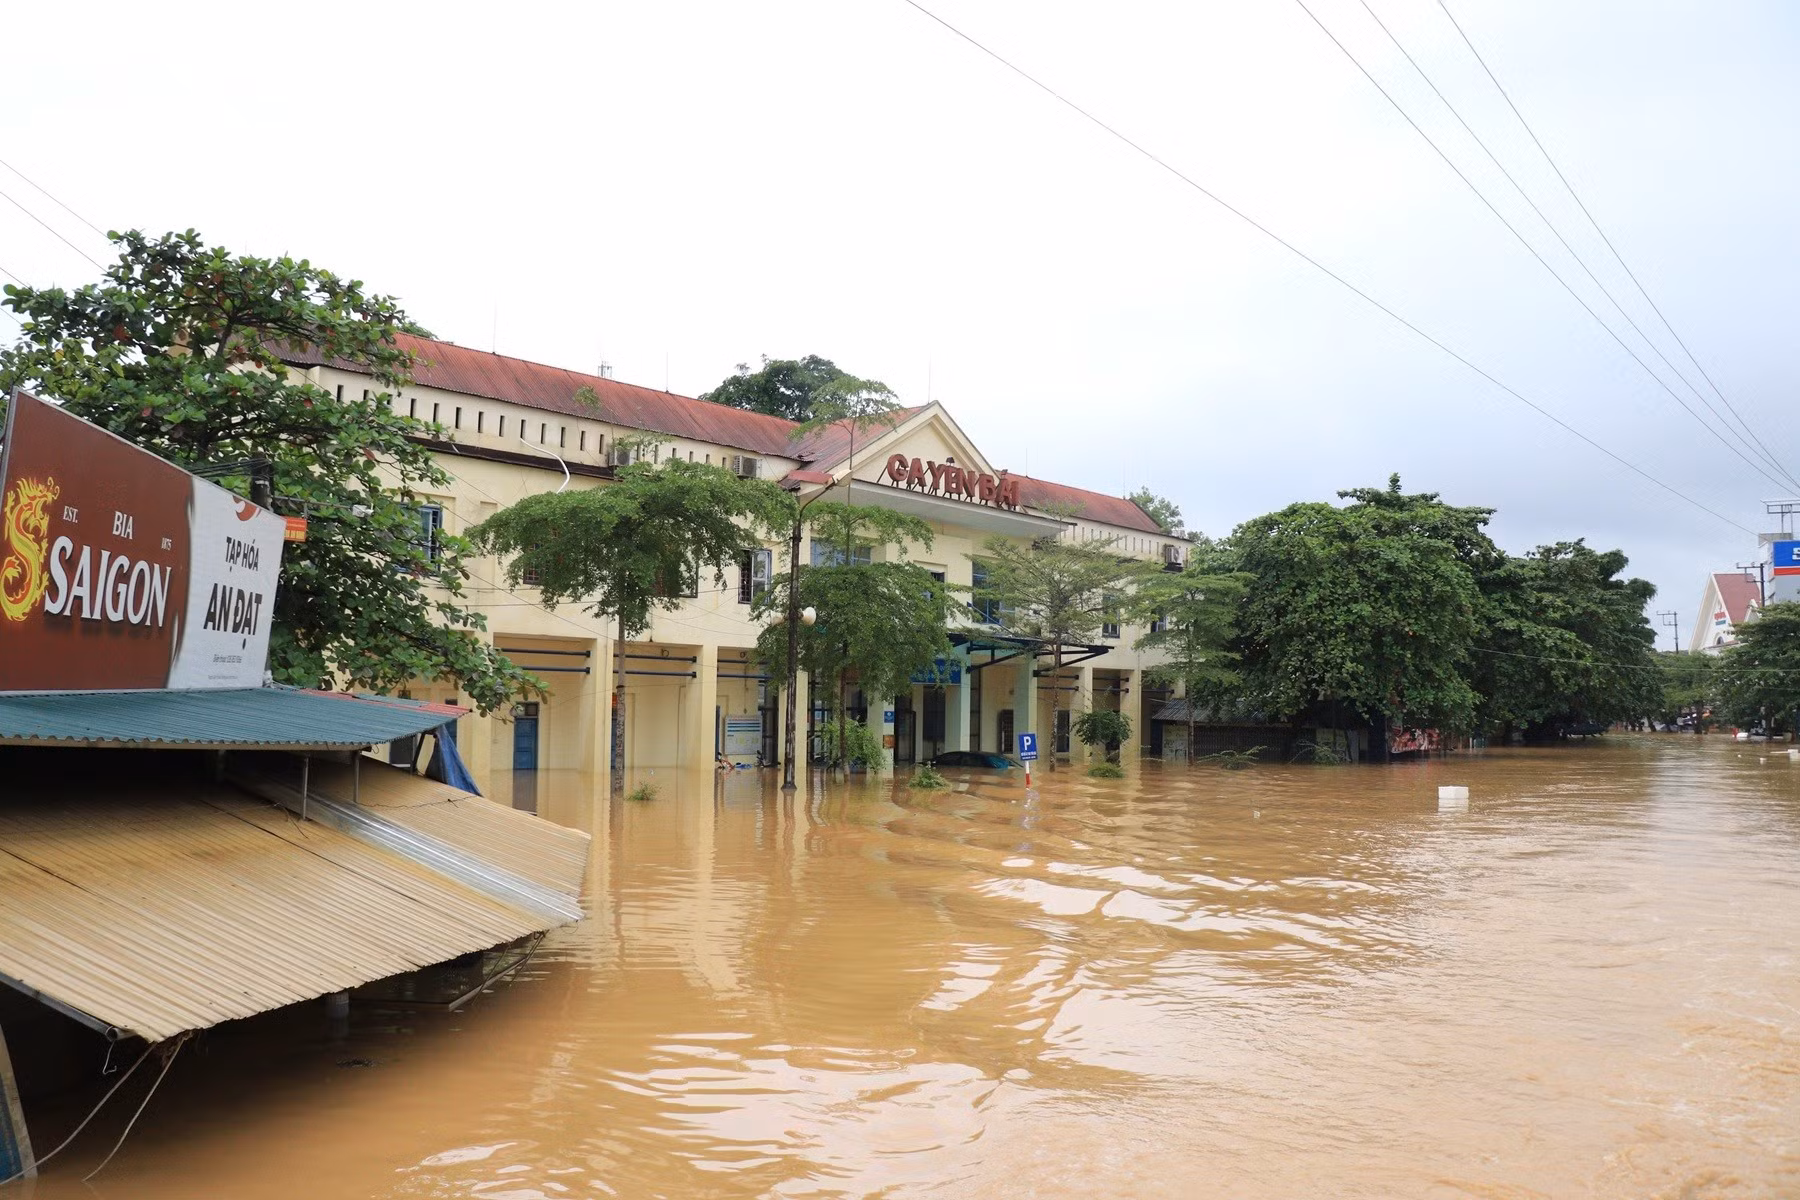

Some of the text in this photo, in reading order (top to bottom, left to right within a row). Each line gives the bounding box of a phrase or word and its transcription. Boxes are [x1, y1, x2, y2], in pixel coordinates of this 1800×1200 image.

[887, 454, 927, 487] GA
[926, 457, 976, 498] YÊN
[63, 505, 79, 523] EST.
[112, 511, 133, 539] BIA
[225, 536, 259, 572] TẠP HÓA
[44, 536, 172, 627] SAIGON
[203, 583, 263, 650] AN ĐẠT
[1023, 736, 1032, 750] P
